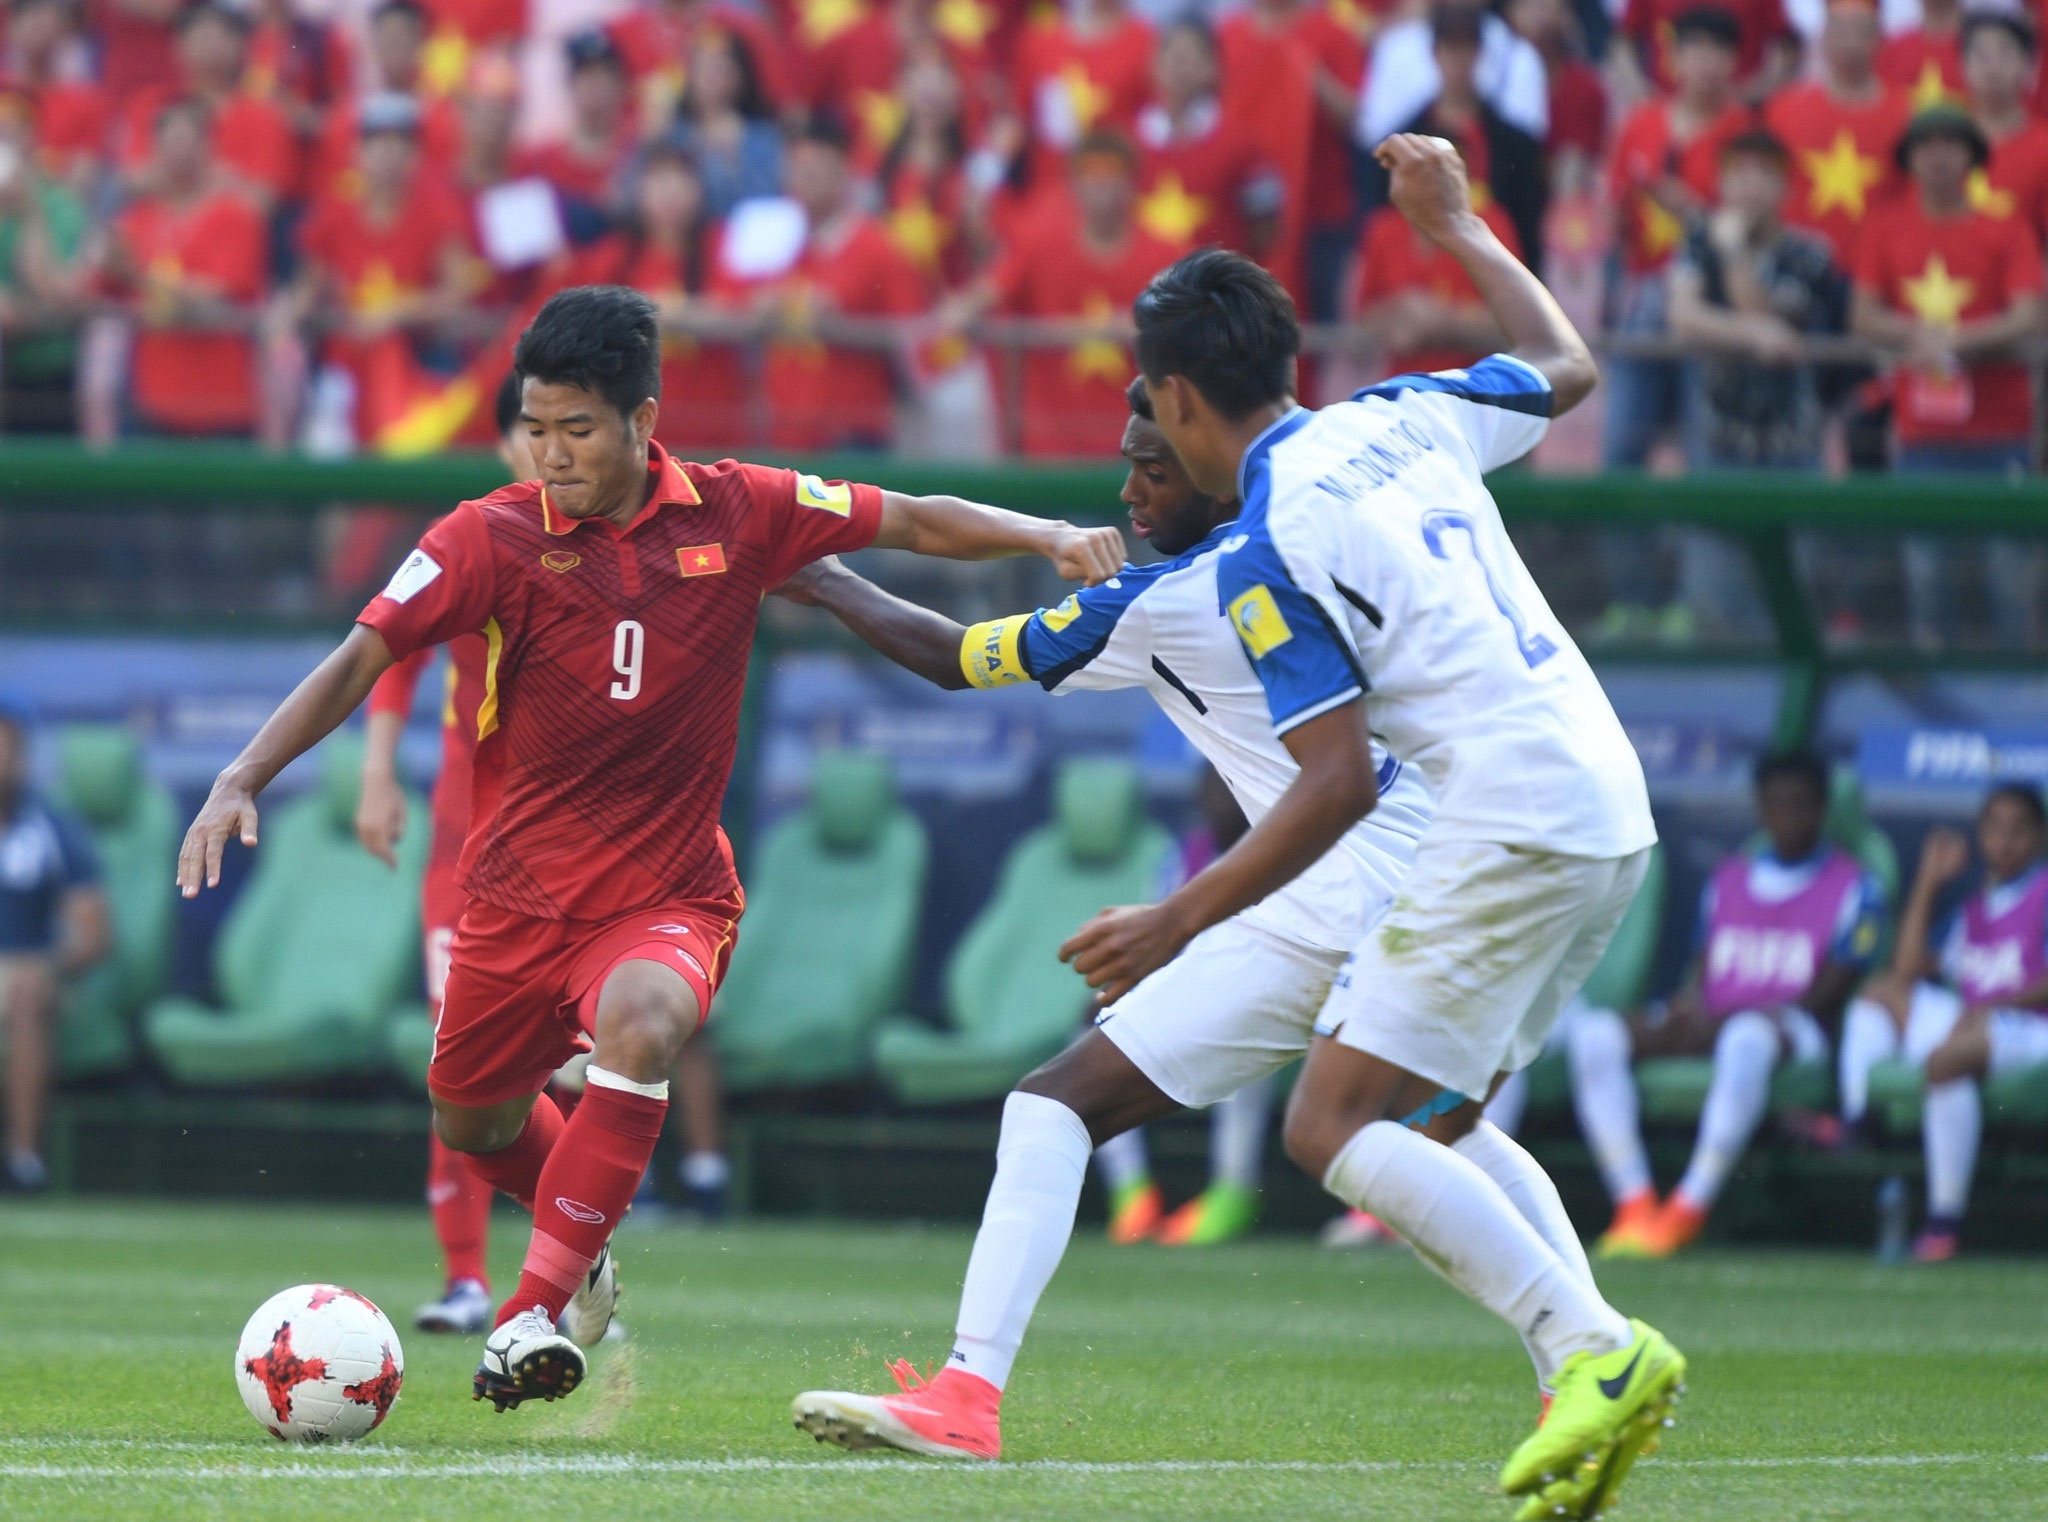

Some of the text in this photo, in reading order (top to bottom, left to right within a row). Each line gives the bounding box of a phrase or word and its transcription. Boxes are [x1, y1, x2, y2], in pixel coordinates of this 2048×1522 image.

[1421, 508, 1560, 670] 2
[610, 620, 645, 700] 9
[985, 624, 1006, 673] FIFA
